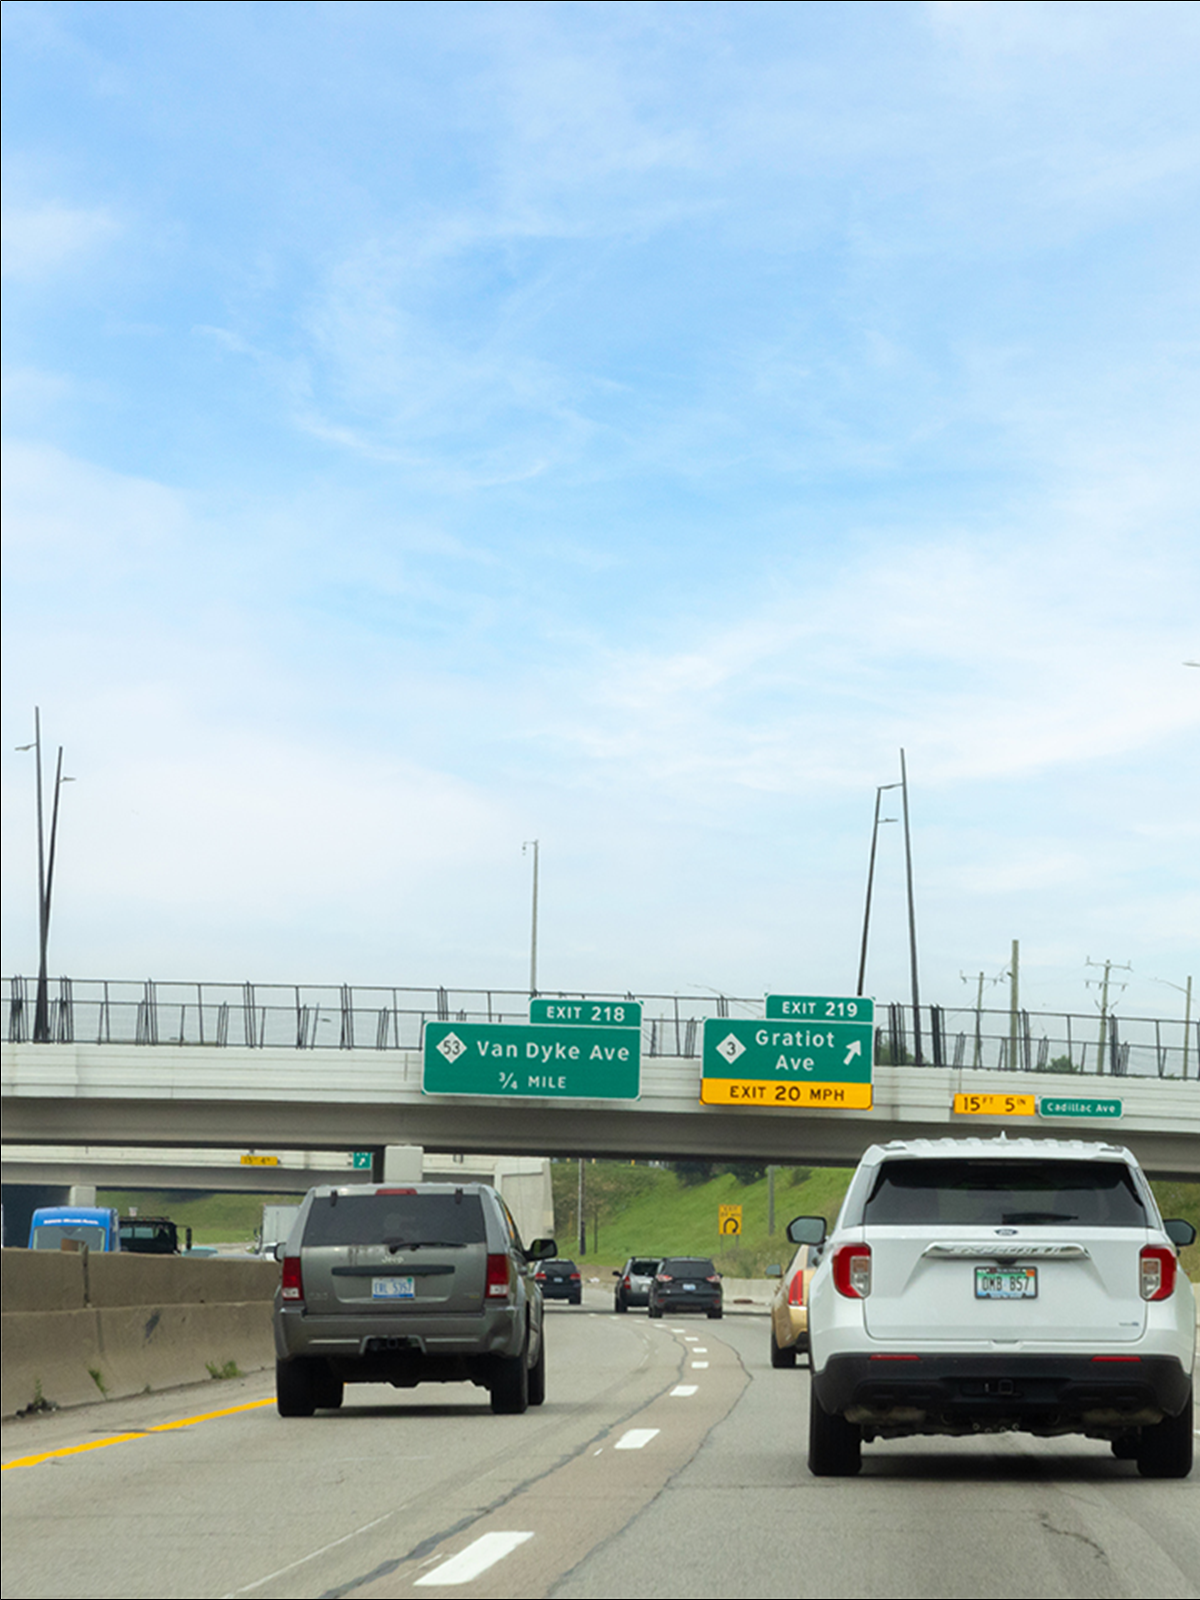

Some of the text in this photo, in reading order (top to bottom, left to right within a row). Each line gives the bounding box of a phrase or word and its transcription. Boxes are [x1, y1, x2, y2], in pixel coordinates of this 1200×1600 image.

[546, 1005, 626, 1022] EXIT 218
[782, 1001, 858, 1018] EXIT 219
[755, 1029, 835, 1048] Gratiot
[443, 1040, 461, 1056] 53
[477, 1040, 630, 1064] Van Dyke Ave
[726, 1041, 737, 1057] 3
[775, 1054, 815, 1072] Ave
[528, 1076, 567, 1089] MILE
[730, 1085, 845, 1102] EXIT 20 MPH
[1046, 1100, 1116, 1114] Cadillac Ave
[381, 1255, 405, 1266] Jeep
